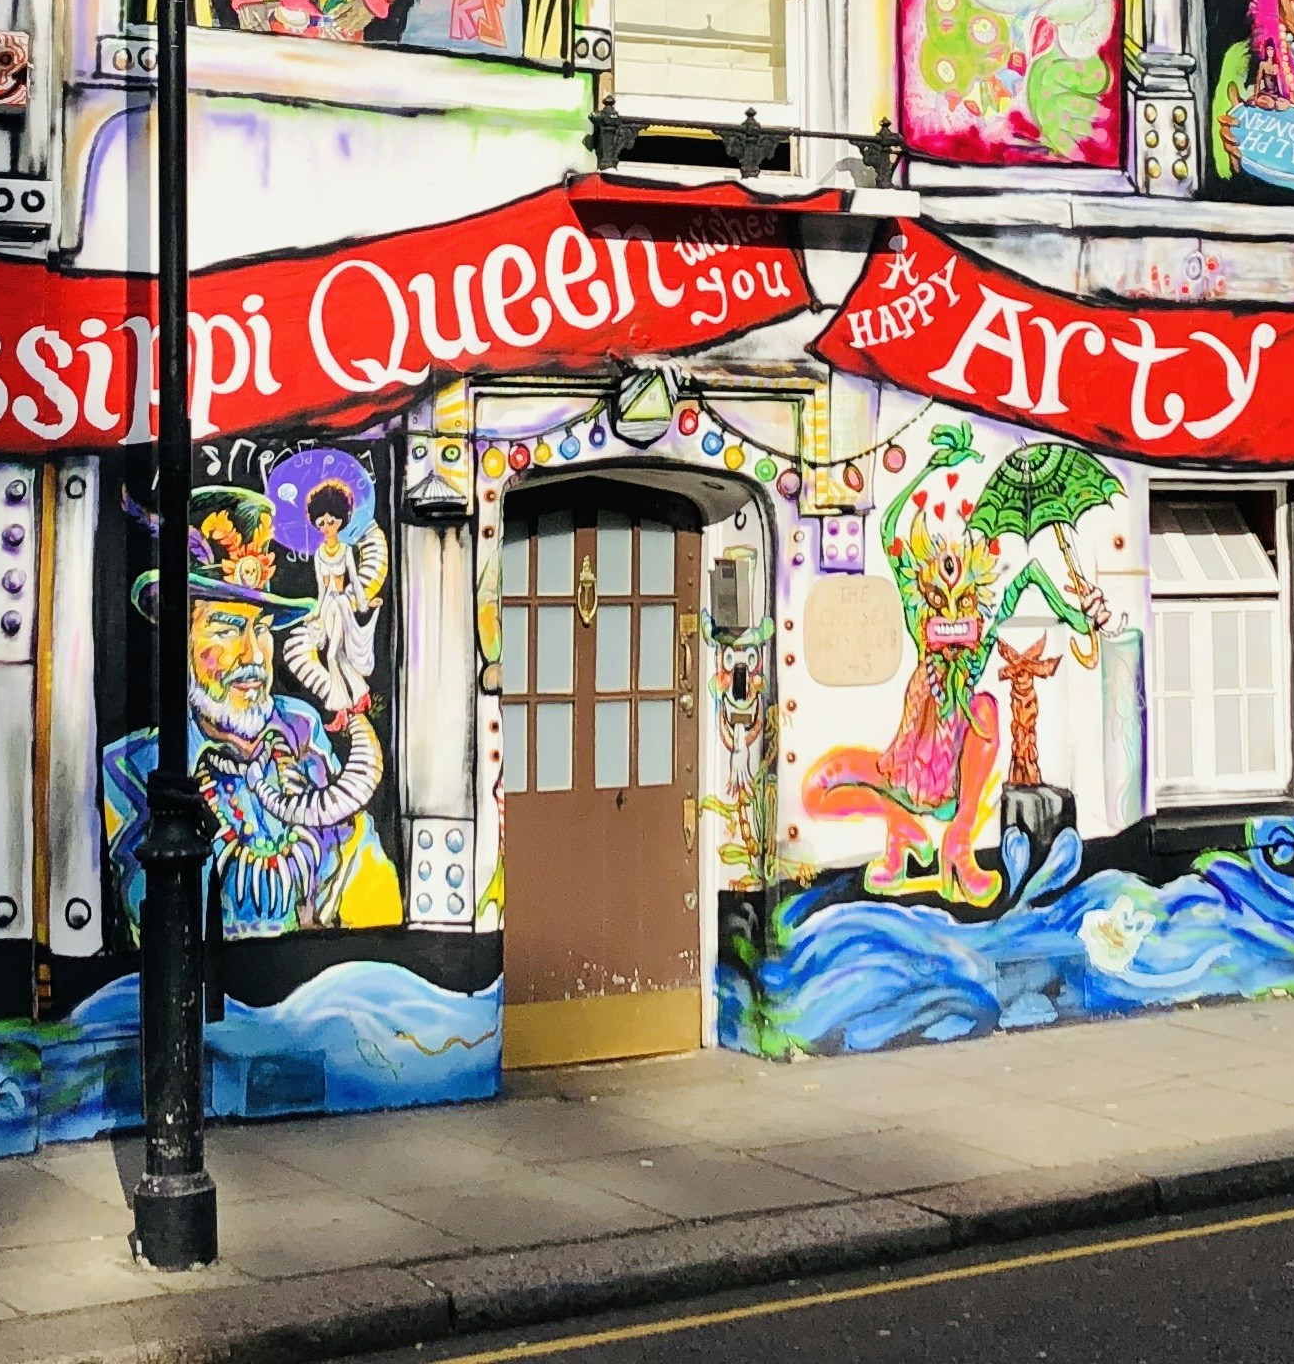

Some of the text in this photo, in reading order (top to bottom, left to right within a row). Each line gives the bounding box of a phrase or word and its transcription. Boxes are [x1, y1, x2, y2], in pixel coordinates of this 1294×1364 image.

[673, 206, 778, 267] wishes
[879, 234, 920, 290] A
[308, 222, 685, 393] Queen
[690, 260, 792, 326] you
[848, 254, 961, 349] HAPPY
[838, 583, 870, 603] THE
